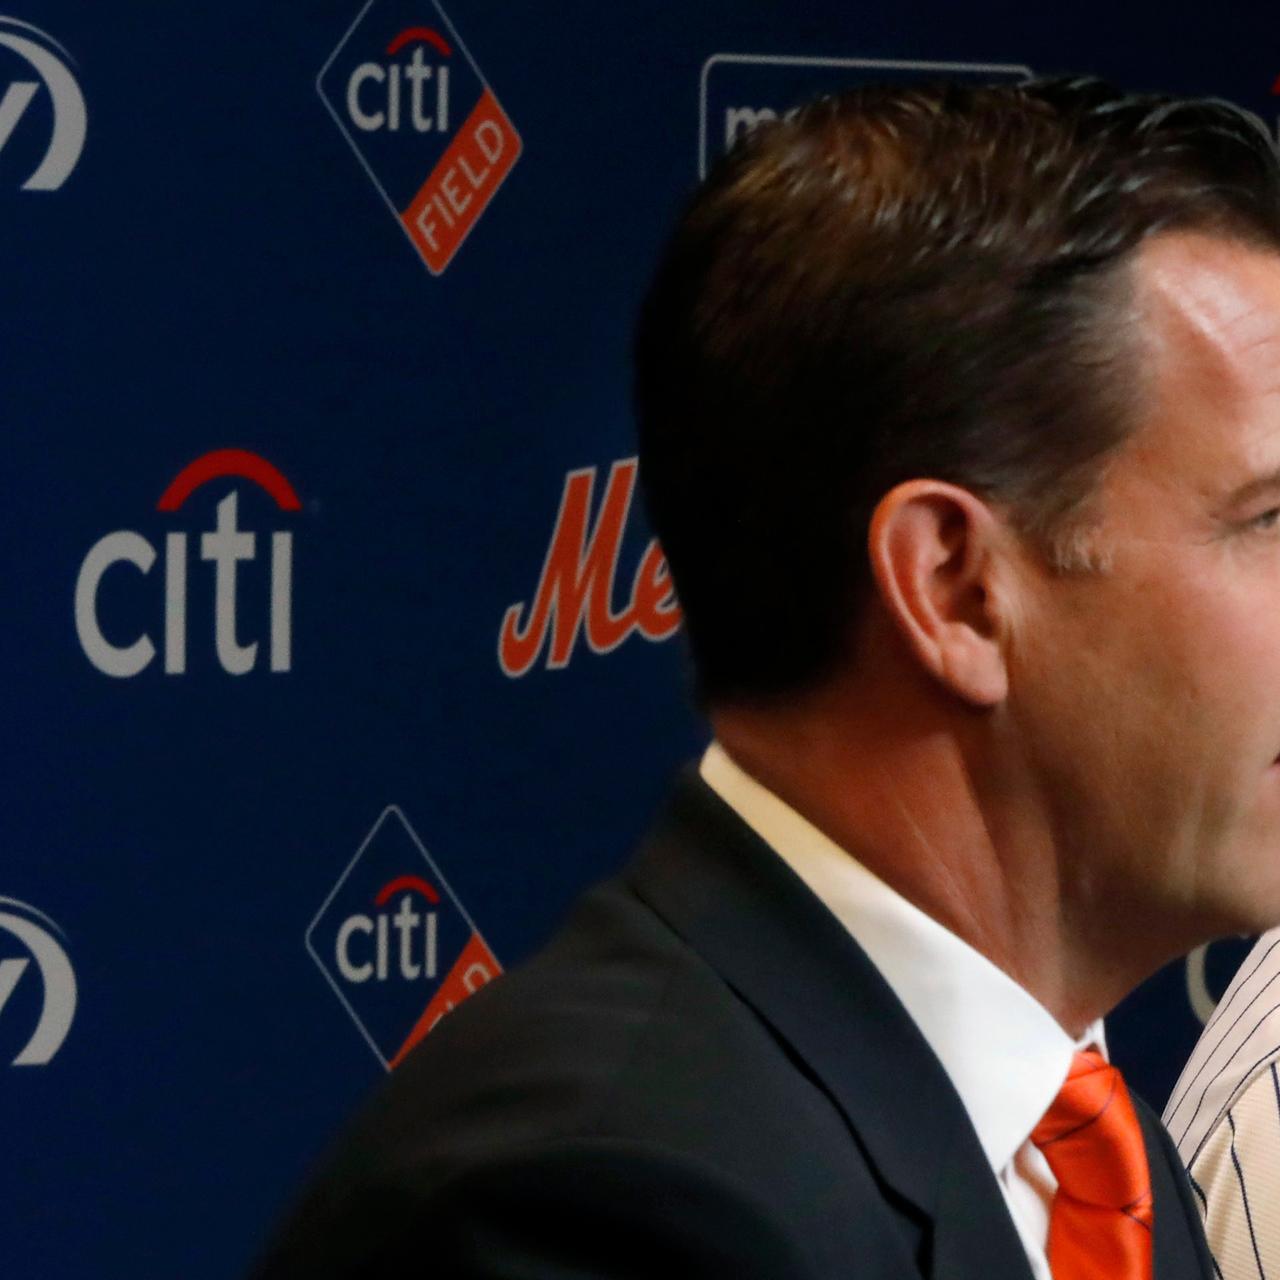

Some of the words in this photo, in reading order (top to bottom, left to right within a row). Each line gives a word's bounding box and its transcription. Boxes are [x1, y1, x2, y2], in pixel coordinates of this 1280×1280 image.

[346, 47, 451, 133] citi
[416, 117, 506, 252] FIELD
[74, 490, 293, 680] citi
[498, 455, 684, 679] Me
[335, 895, 439, 984] citi
